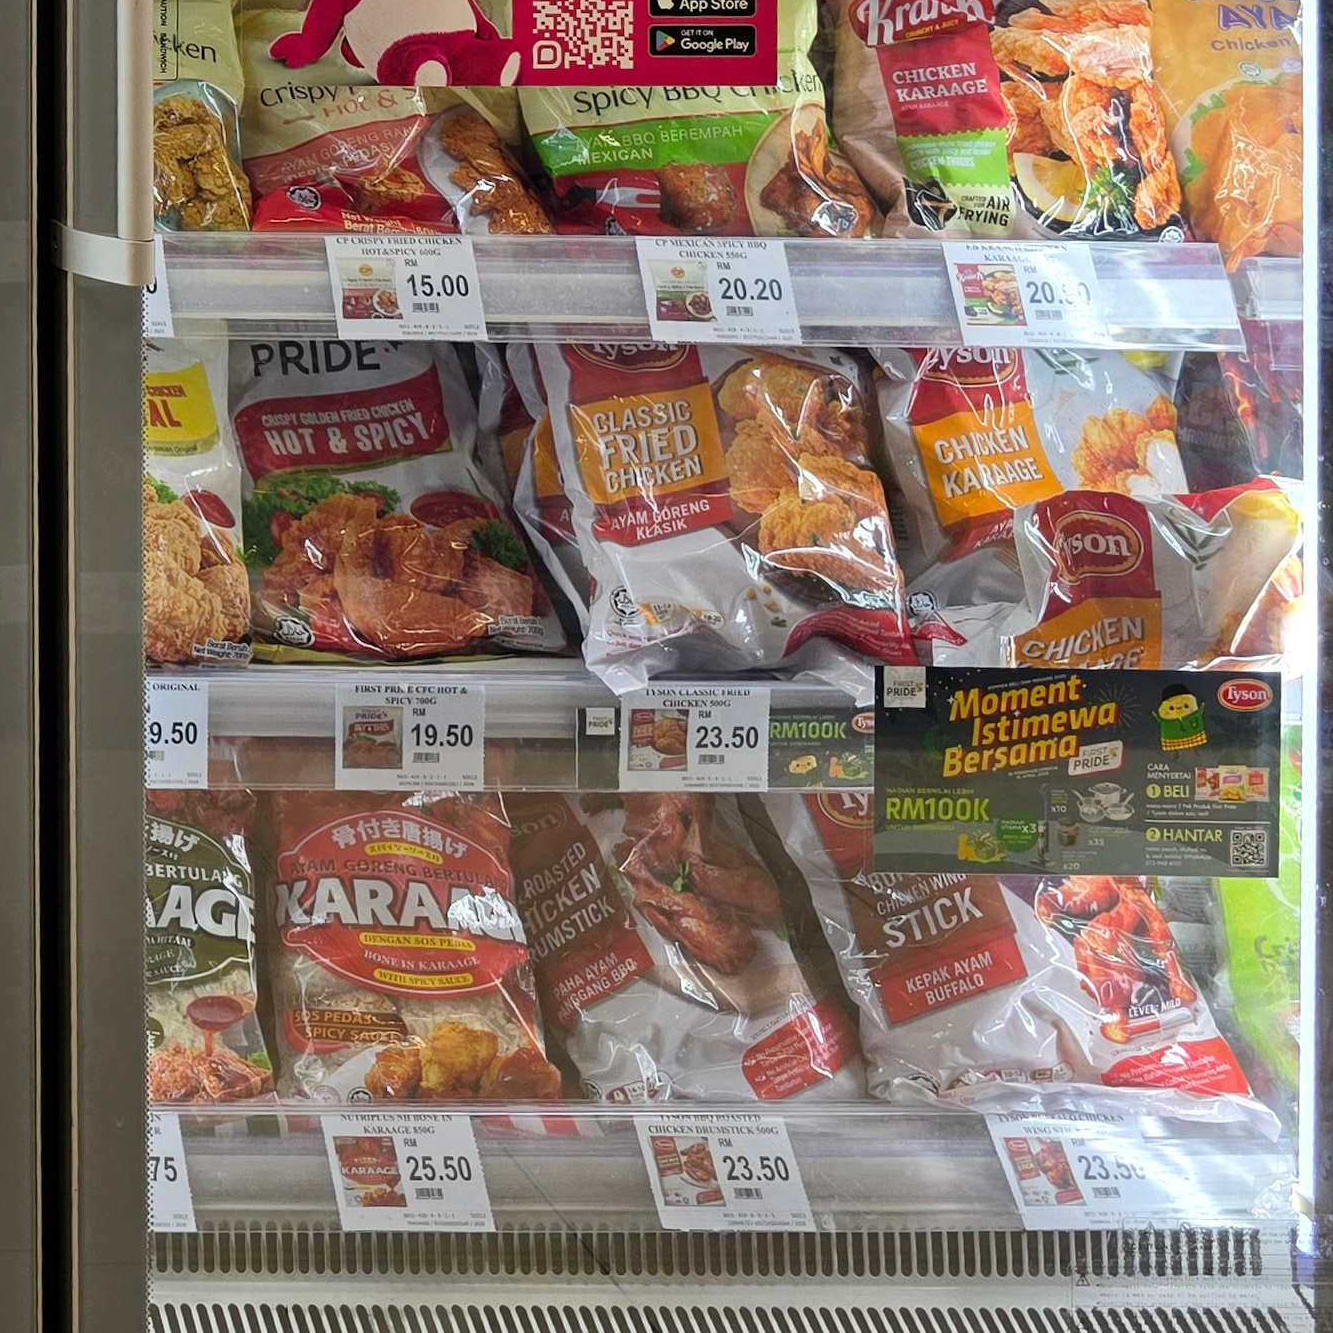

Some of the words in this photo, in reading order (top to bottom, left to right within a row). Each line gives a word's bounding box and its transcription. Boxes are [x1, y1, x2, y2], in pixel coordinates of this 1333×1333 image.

[893, 62, 976, 83] CHICKEN
[895, 80, 988, 103] KARAAGE
[987, 195, 1010, 213] AIR
[959, 207, 1009, 227] FRYING
[361, 248, 416, 257] HOT&SPICY
[419, 248, 441, 256] 600G
[406, 274, 469, 298] 15.00
[719, 278, 782, 301] 20.20
[593, 400, 691, 434] CLASSIC
[266, 431, 313, 457] HOT
[328, 428, 349, 454] &
[356, 415, 431, 451] SPICY
[600, 427, 699, 468] FRIED
[604, 459, 703, 495] CHICKEN
[949, 675, 1081, 719] Moment
[1225, 686, 1267, 703] Tyson
[972, 701, 1116, 745] Istimewa
[411, 724, 473, 748] 19.50
[944, 735, 1078, 777] Bersama
[1147, 772, 1191, 780] MENYERTAI
[1164, 785, 1189, 798] BELI
[887, 797, 989, 821] RM100K
[331, 818, 468, 859] 骨付き唐揚げ
[1163, 829, 1222, 843] HANTAR
[882, 888, 983, 949] STICK
[906, 968, 950, 994] KEPAK
[954, 951, 992, 976] AYAM
[925, 974, 984, 1005] BUFFALO
[363, 1126, 411, 1135] KARAAGE
[413, 1126, 434, 1134] 850G
[409, 1157, 472, 1181] 25.50
[722, 1156, 790, 1181] 23.50
